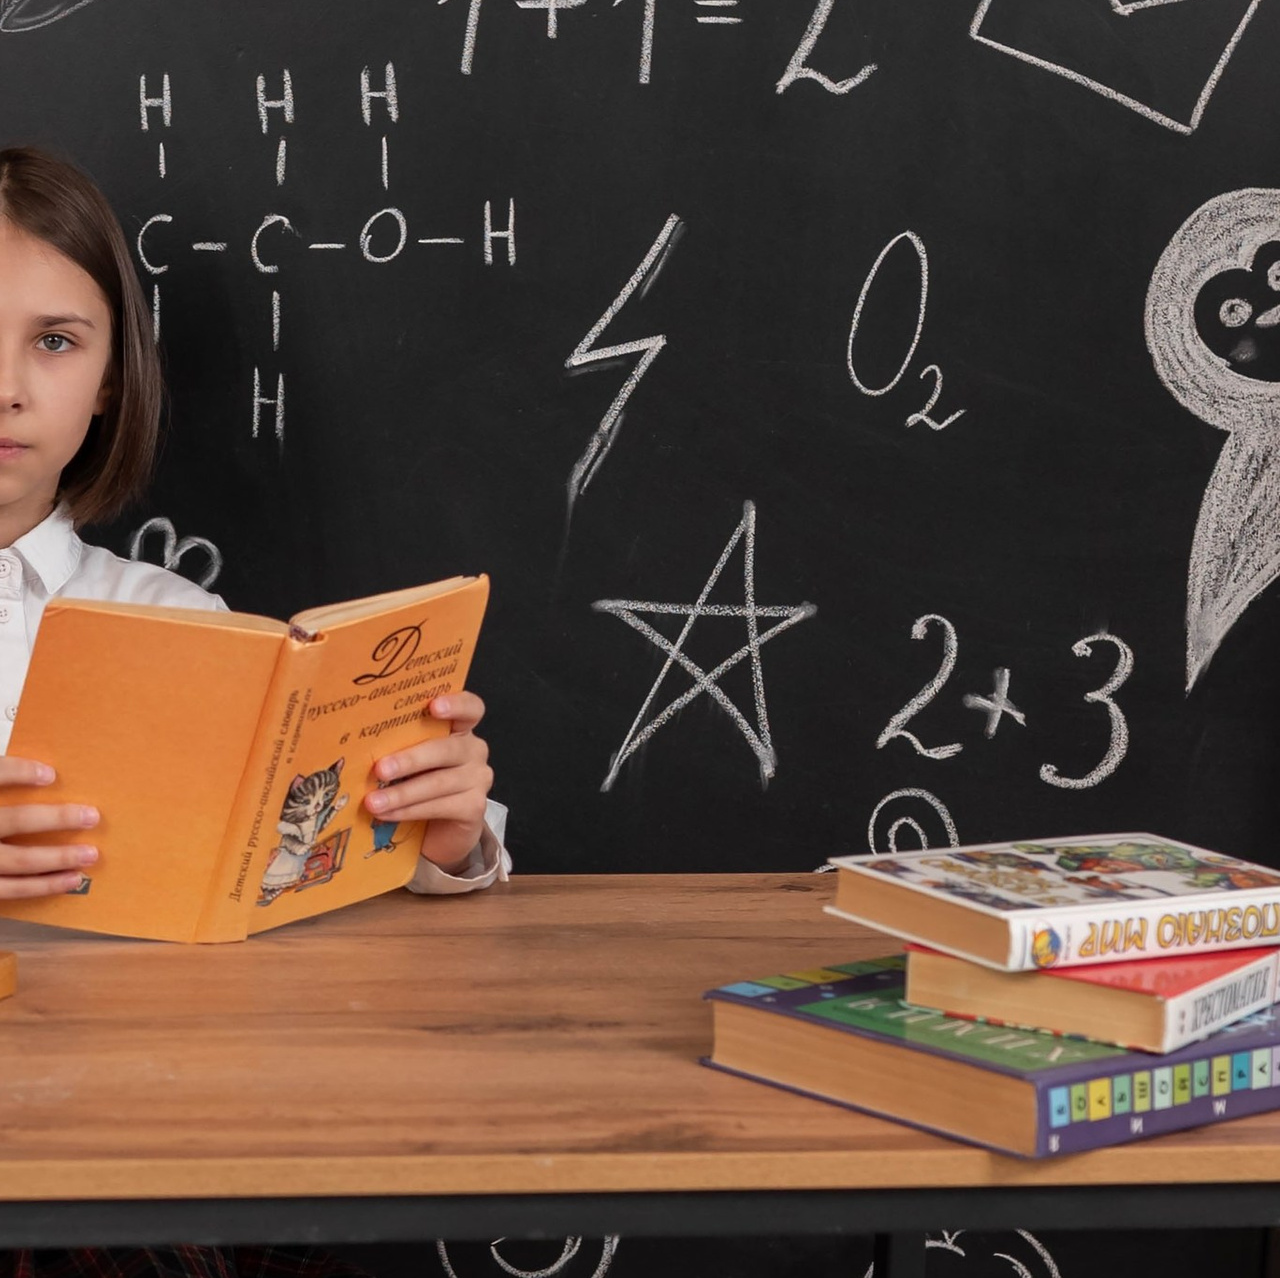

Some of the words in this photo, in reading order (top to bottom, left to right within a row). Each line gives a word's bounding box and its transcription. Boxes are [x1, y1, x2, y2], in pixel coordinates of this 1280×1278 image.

[352, 618, 463, 686] Детский
[307, 660, 458, 721] русско-английский
[393, 682, 452, 711] словарь
[228, 850, 253, 903] Детский
[280, 689, 300, 737] словарь
[1078, 917, 1147, 958] МИР
[1157, 899, 1280, 950] ПОЗНАЮ
